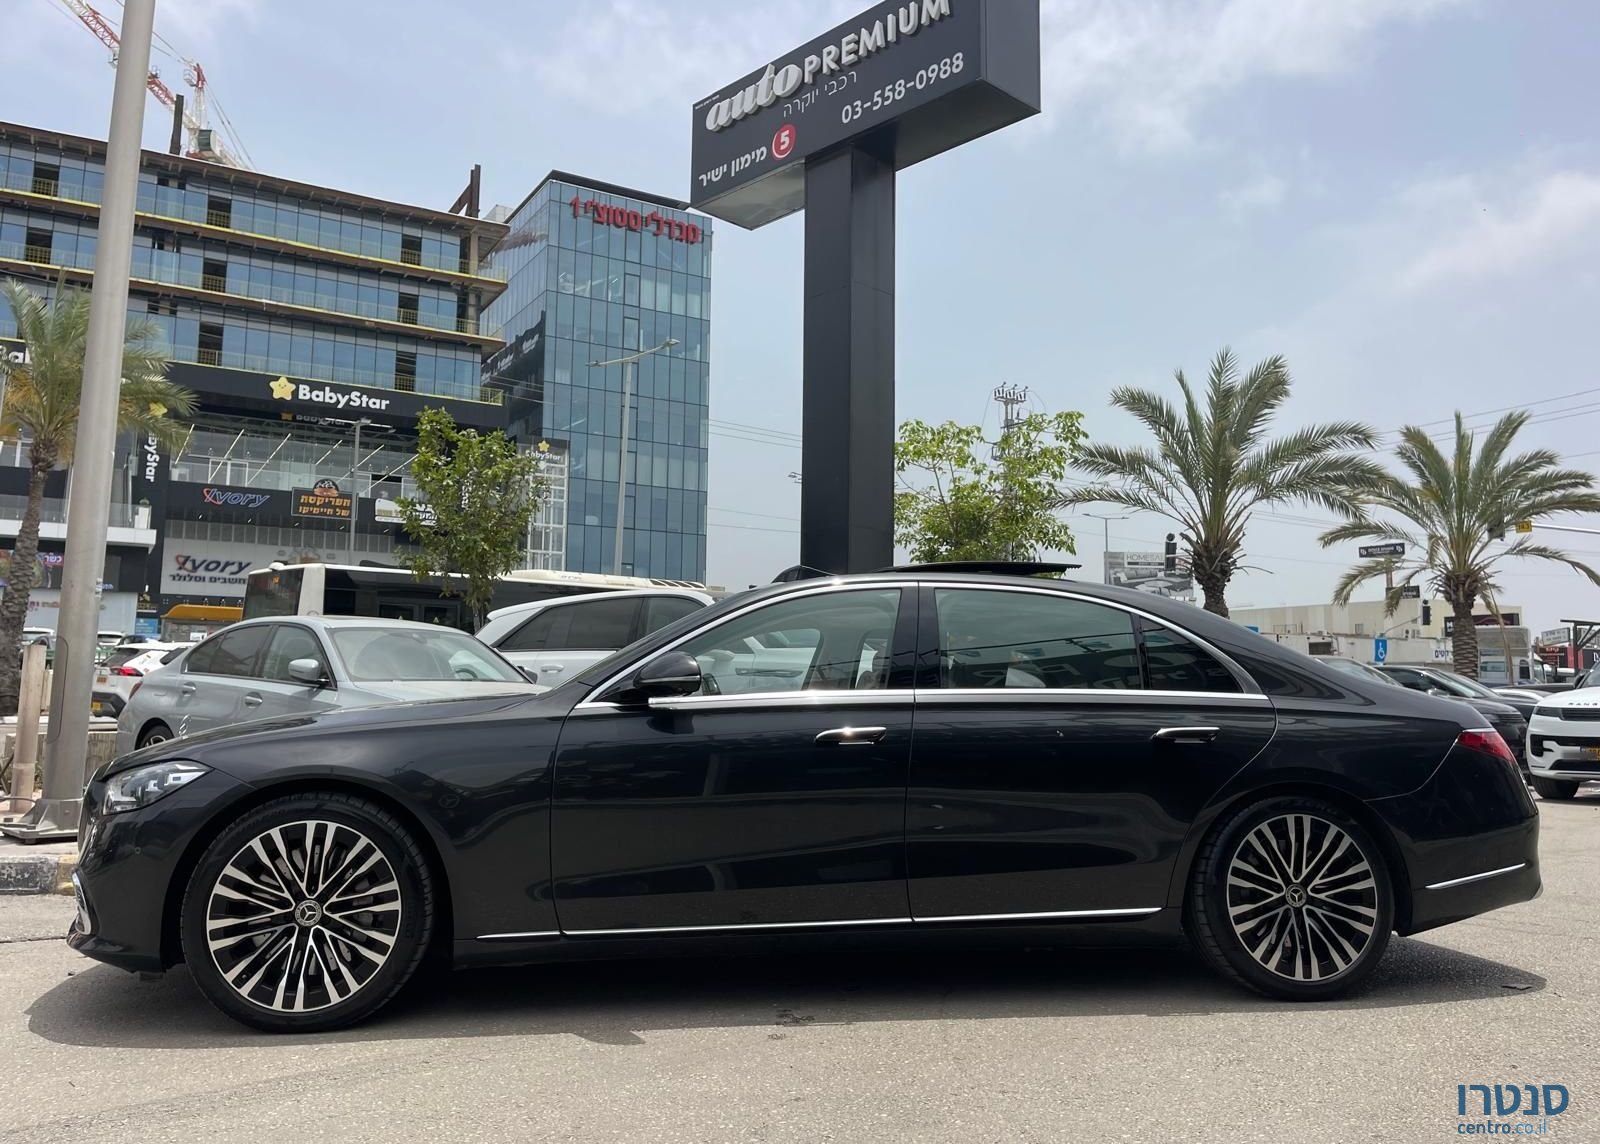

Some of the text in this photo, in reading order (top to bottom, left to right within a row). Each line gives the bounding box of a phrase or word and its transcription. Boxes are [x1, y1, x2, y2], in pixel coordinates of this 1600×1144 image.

[706, 0, 950, 132] auto PREMIUM
[783, 71, 857, 118] רכבי יוקרה
[841, 52, 964, 124] 03-558-0988
[780, 130, 790, 150] 5
[698, 146, 767, 187] מימון ישיר
[298, 384, 390, 410] BabyStar
[169, 573, 247, 585] חשבים וסלולר
[175, 554, 252, 576] Ivory
